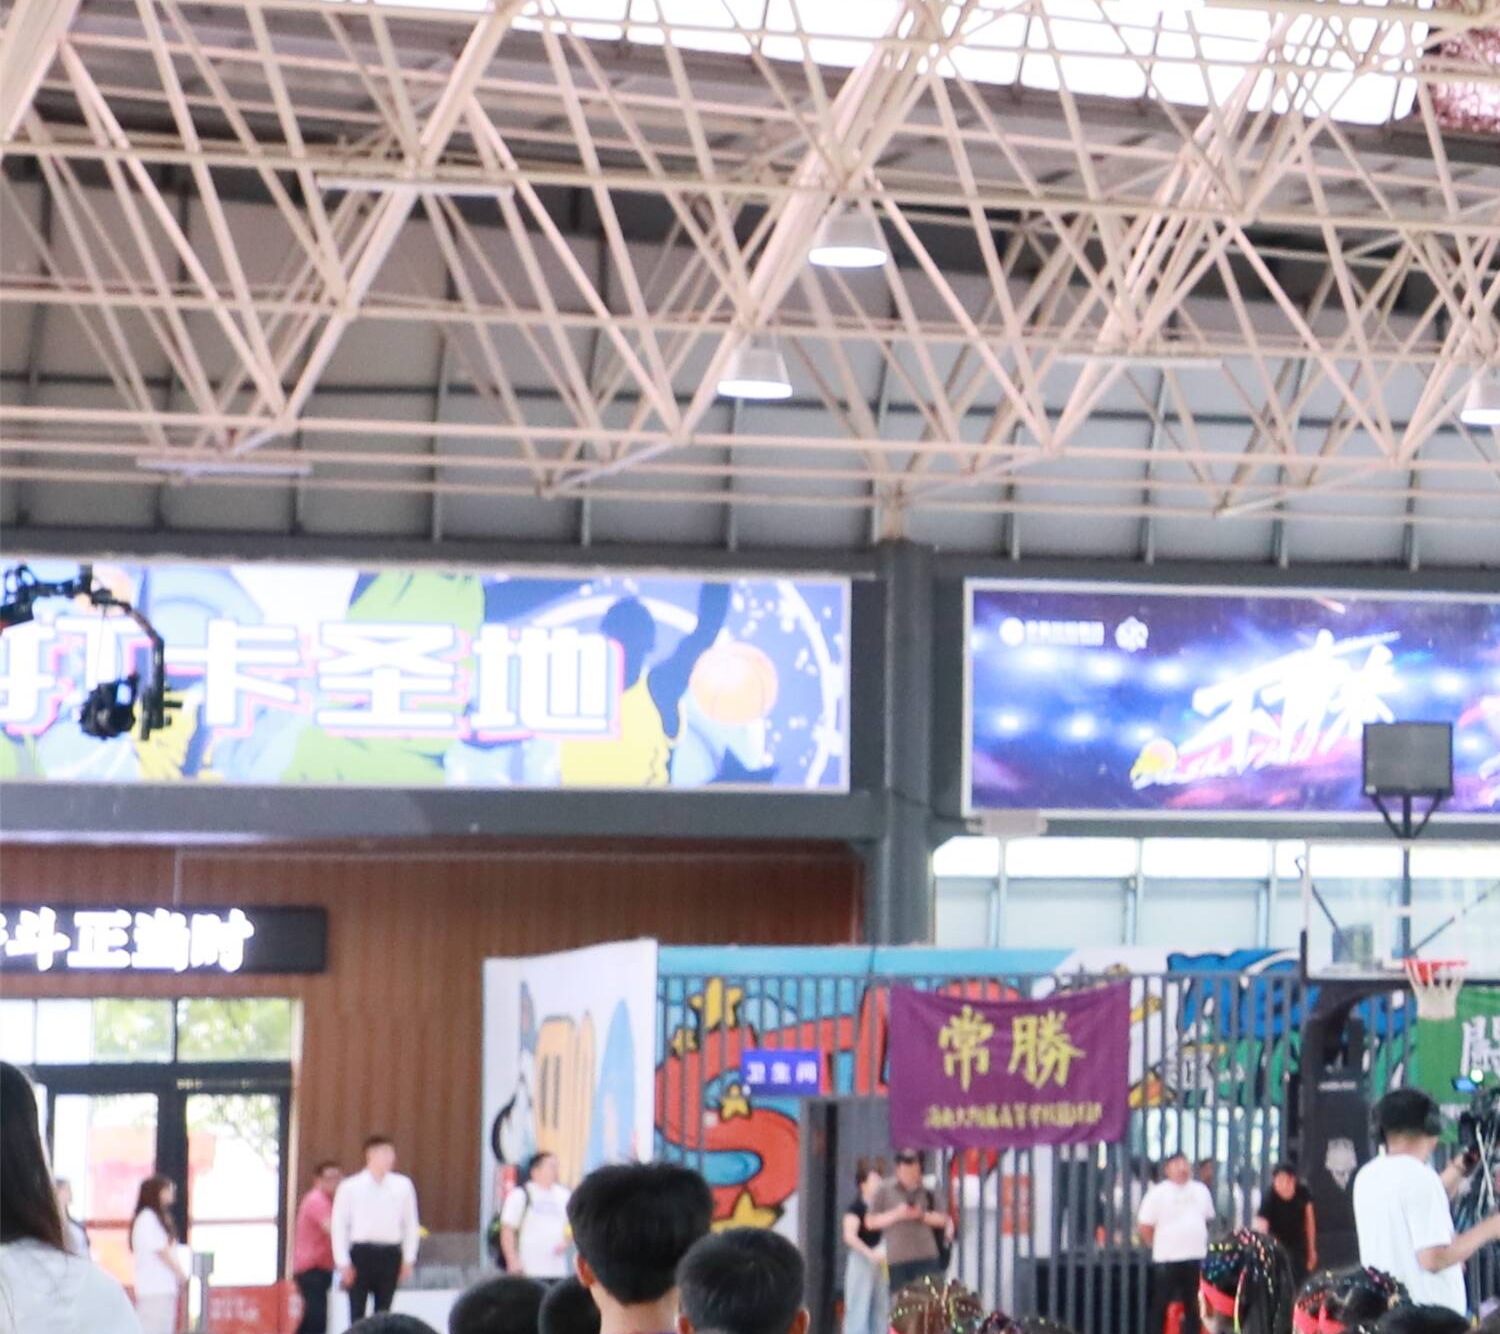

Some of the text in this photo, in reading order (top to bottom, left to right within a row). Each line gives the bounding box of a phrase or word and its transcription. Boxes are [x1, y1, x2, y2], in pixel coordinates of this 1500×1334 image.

[0, 615, 608, 729] 打卡圣地
[0, 906, 255, 971] 斗正当时
[938, 1006, 1088, 1092] 常勝
